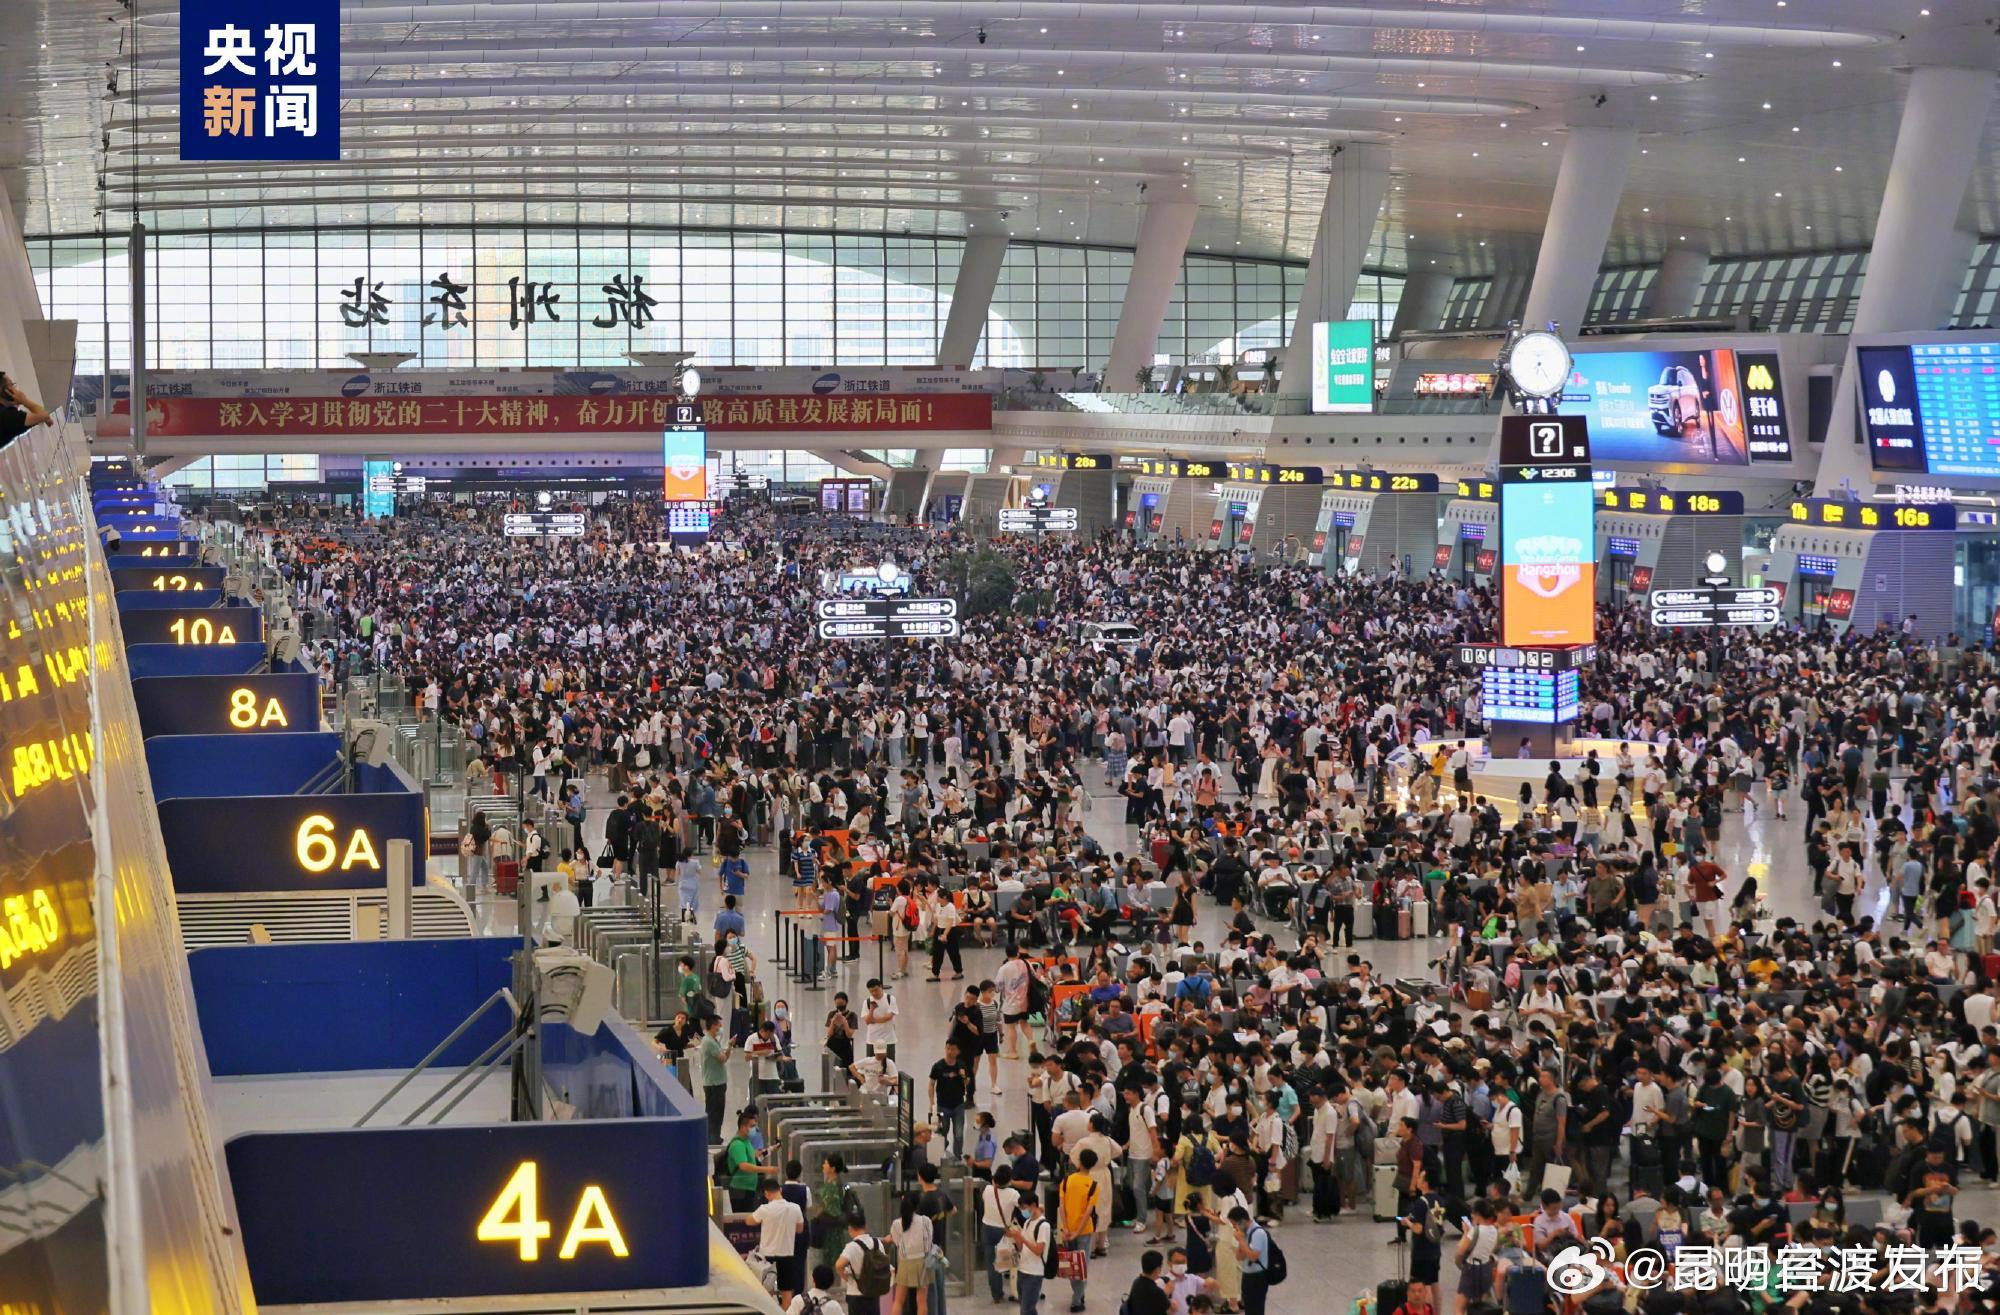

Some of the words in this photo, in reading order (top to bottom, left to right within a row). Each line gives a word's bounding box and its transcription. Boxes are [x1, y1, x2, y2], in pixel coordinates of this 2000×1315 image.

[374, 382, 422, 394] 浙江铁道
[844, 380, 890, 391] 浙江铁道
[219, 398, 934, 428] 深入学习贯彻党的二十大精神，奋力开创路高质量发展新局面！
[1187, 464, 1210, 476] 26B
[1279, 469, 1305, 482] 24B
[1541, 469, 1577, 478] 12306
[1391, 476, 1418, 490] 22B
[1688, 495, 1720, 512] 18B
[1893, 507, 1930, 526] 16B
[1519, 563, 1579, 578] Hangzhou
[170, 618, 236, 645] 10A
[229, 688, 288, 728] 8A
[296, 815, 381, 872] 6A
[477, 1160, 630, 1261] 4A
